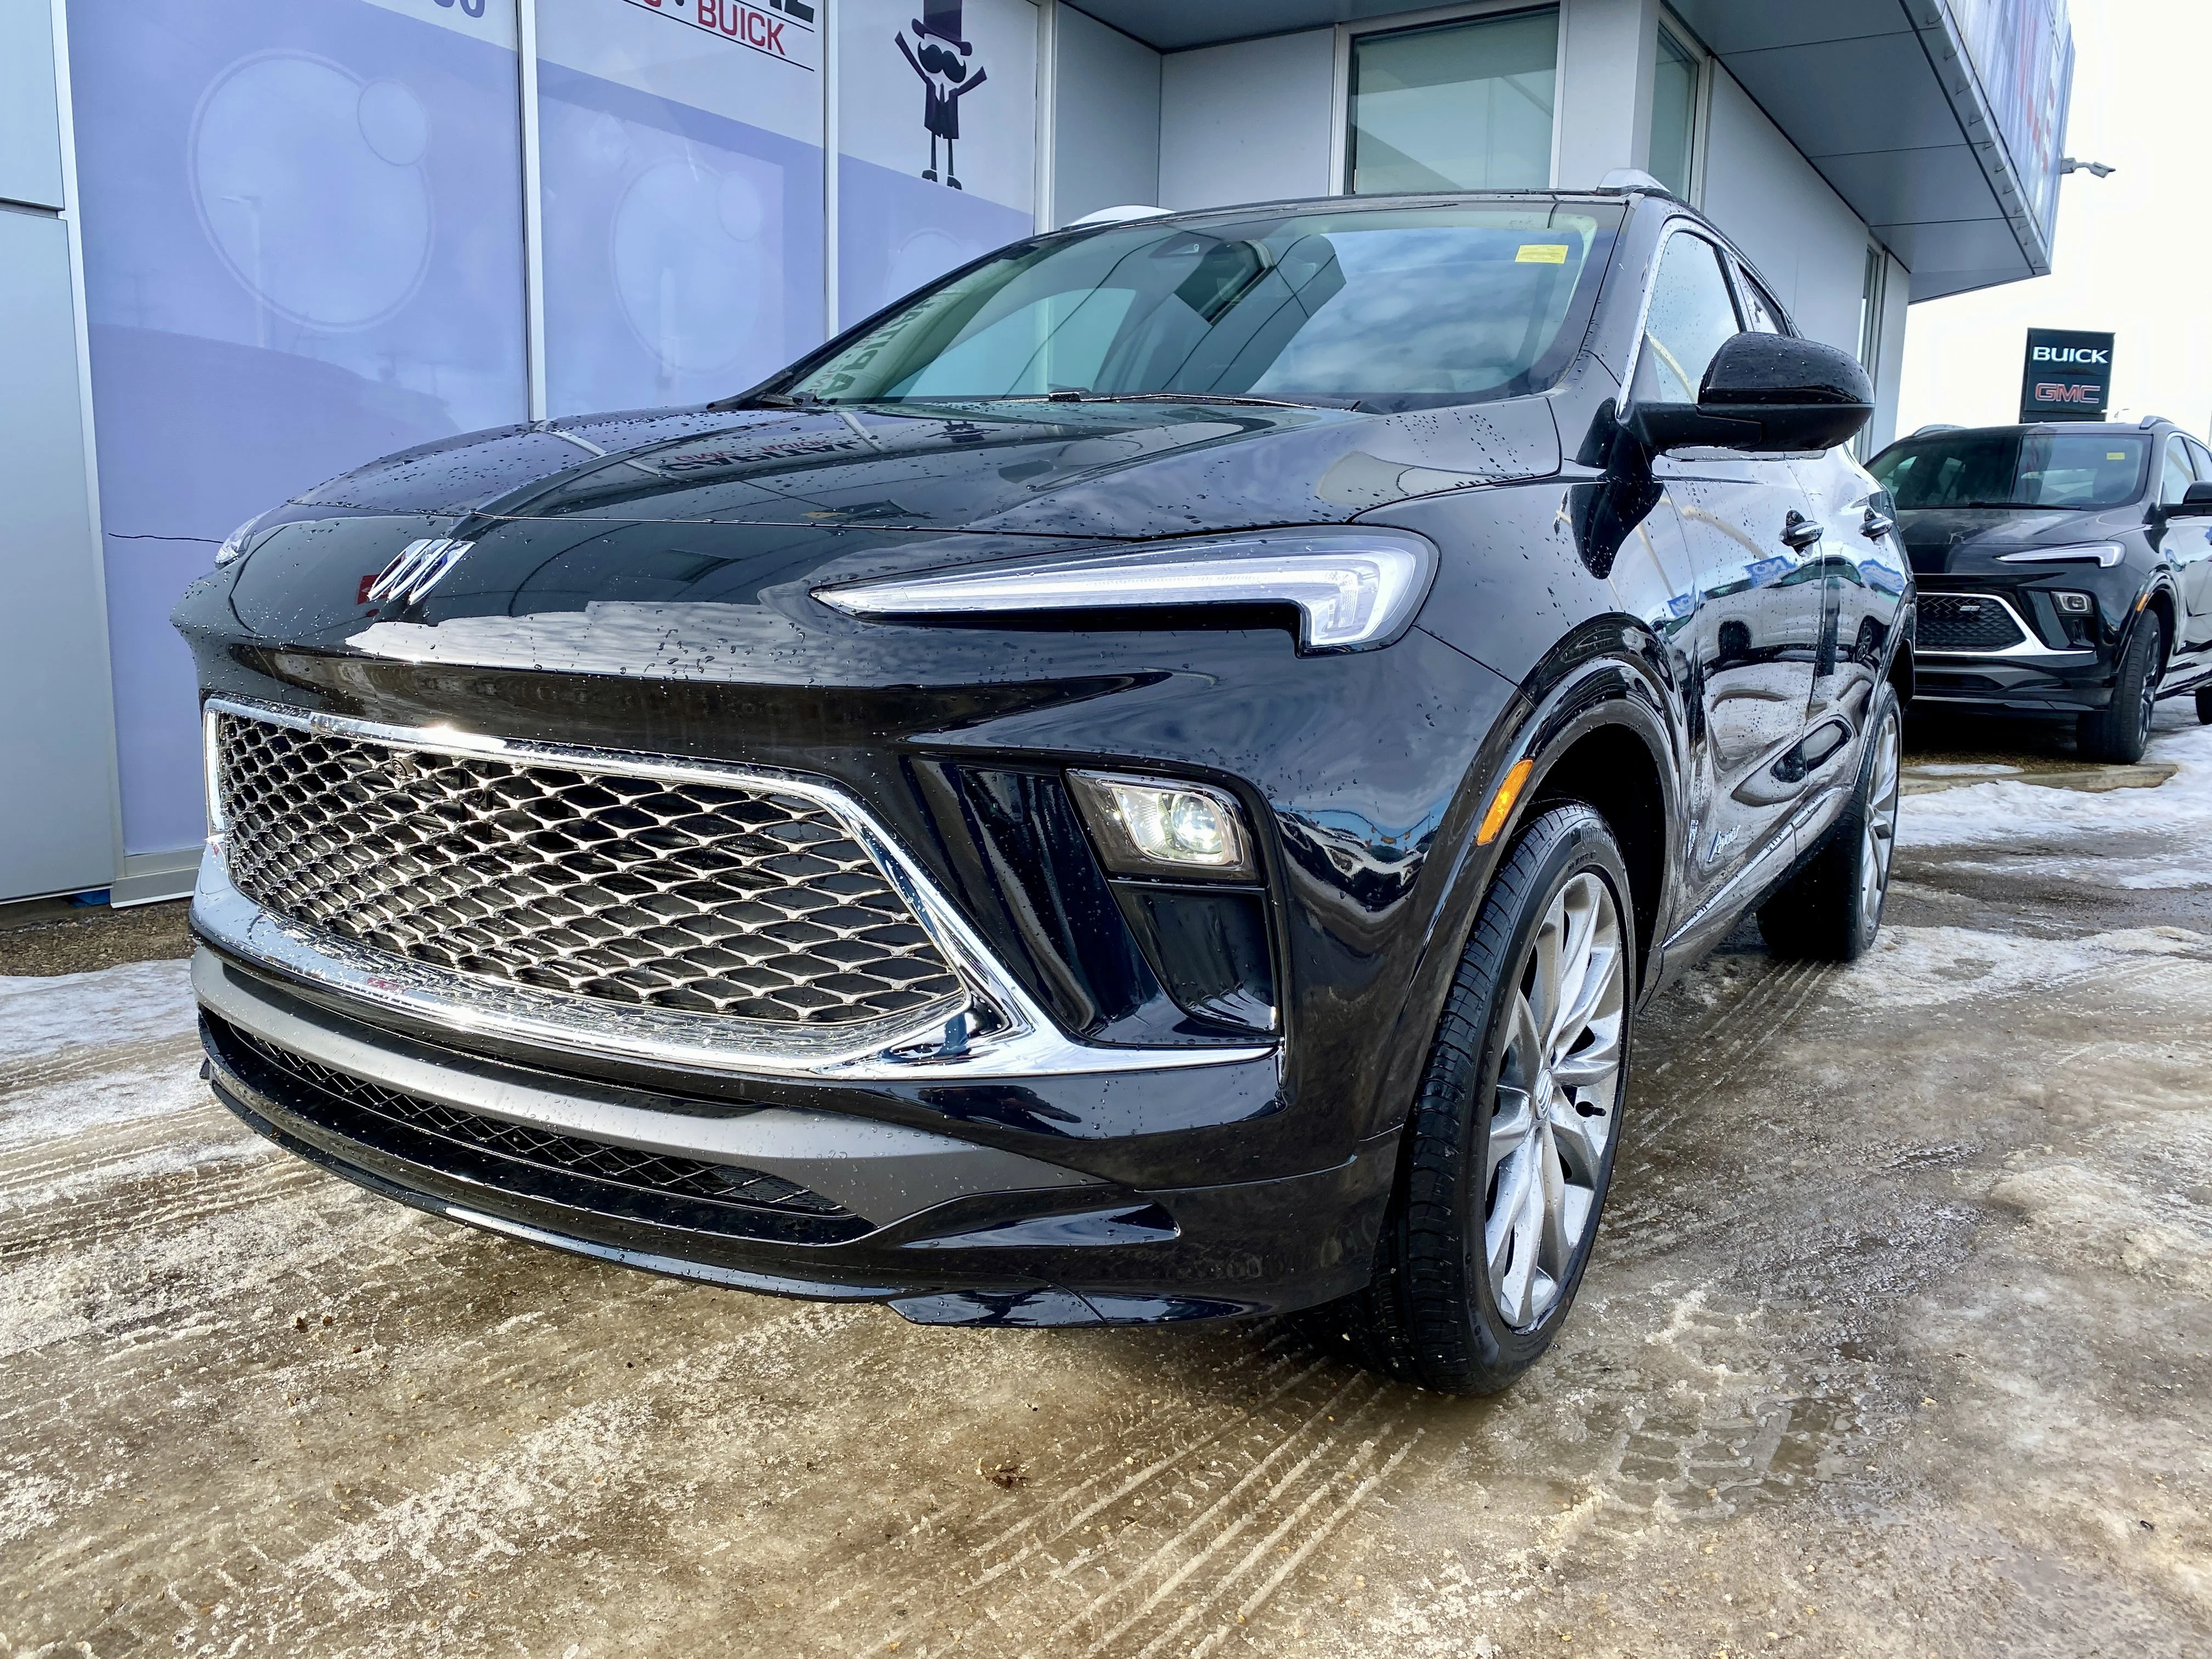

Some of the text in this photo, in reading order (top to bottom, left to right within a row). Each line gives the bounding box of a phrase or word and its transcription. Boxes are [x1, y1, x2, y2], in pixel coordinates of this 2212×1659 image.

[698, 0, 786, 56] BUICK
[2033, 346, 2109, 364] BUICK
[2035, 382, 2101, 404] GMC
